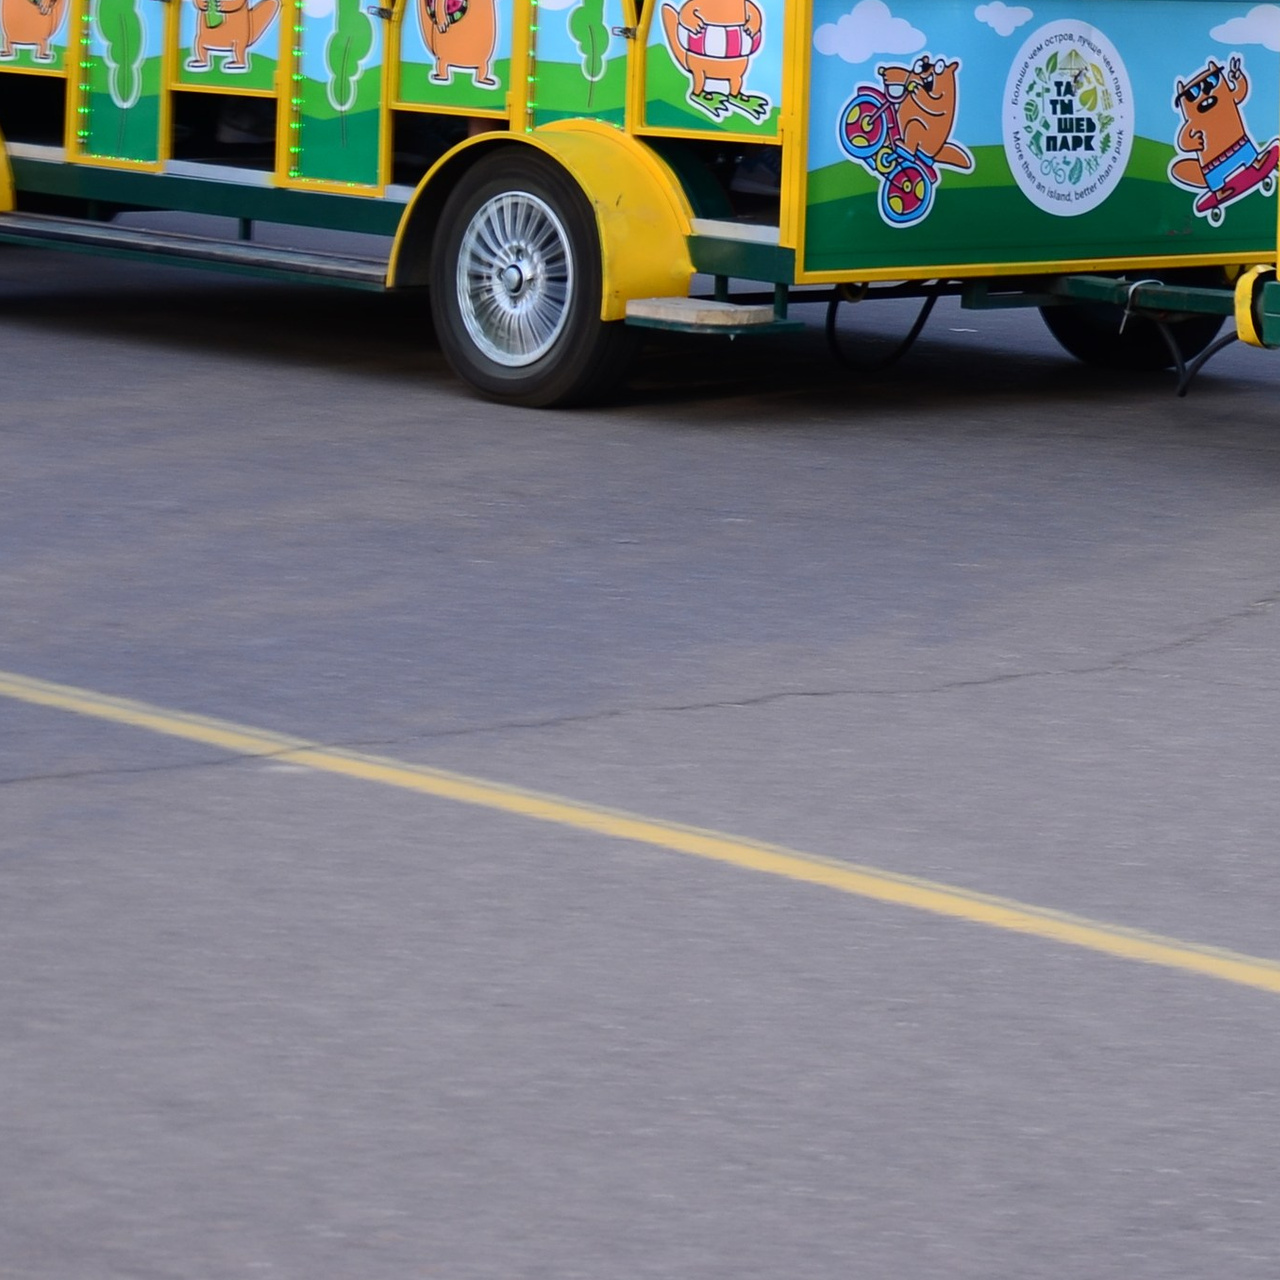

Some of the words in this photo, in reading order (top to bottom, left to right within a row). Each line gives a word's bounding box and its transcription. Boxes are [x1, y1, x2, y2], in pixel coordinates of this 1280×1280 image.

[1011, 61, 1029, 105] Больше
[1028, 44, 1043, 60] чем
[1044, 33, 1075, 47] остров,
[1077, 35, 1102, 56] лучше
[1103, 54, 1115, 75] чем
[1112, 77, 1124, 105] парк
[1054, 81, 1076, 97] ТА
[1057, 117, 1096, 133] ШЕВ
[1046, 135, 1095, 152] ПАРК
[1013, 130, 1023, 161] More
[1022, 161, 1036, 184] than
[1036, 182, 1046, 194] an
[1046, 187, 1073, 203] island,
[1074, 182, 1098, 200] better
[1097, 164, 1113, 185] than
[1114, 129, 1125, 155] park
